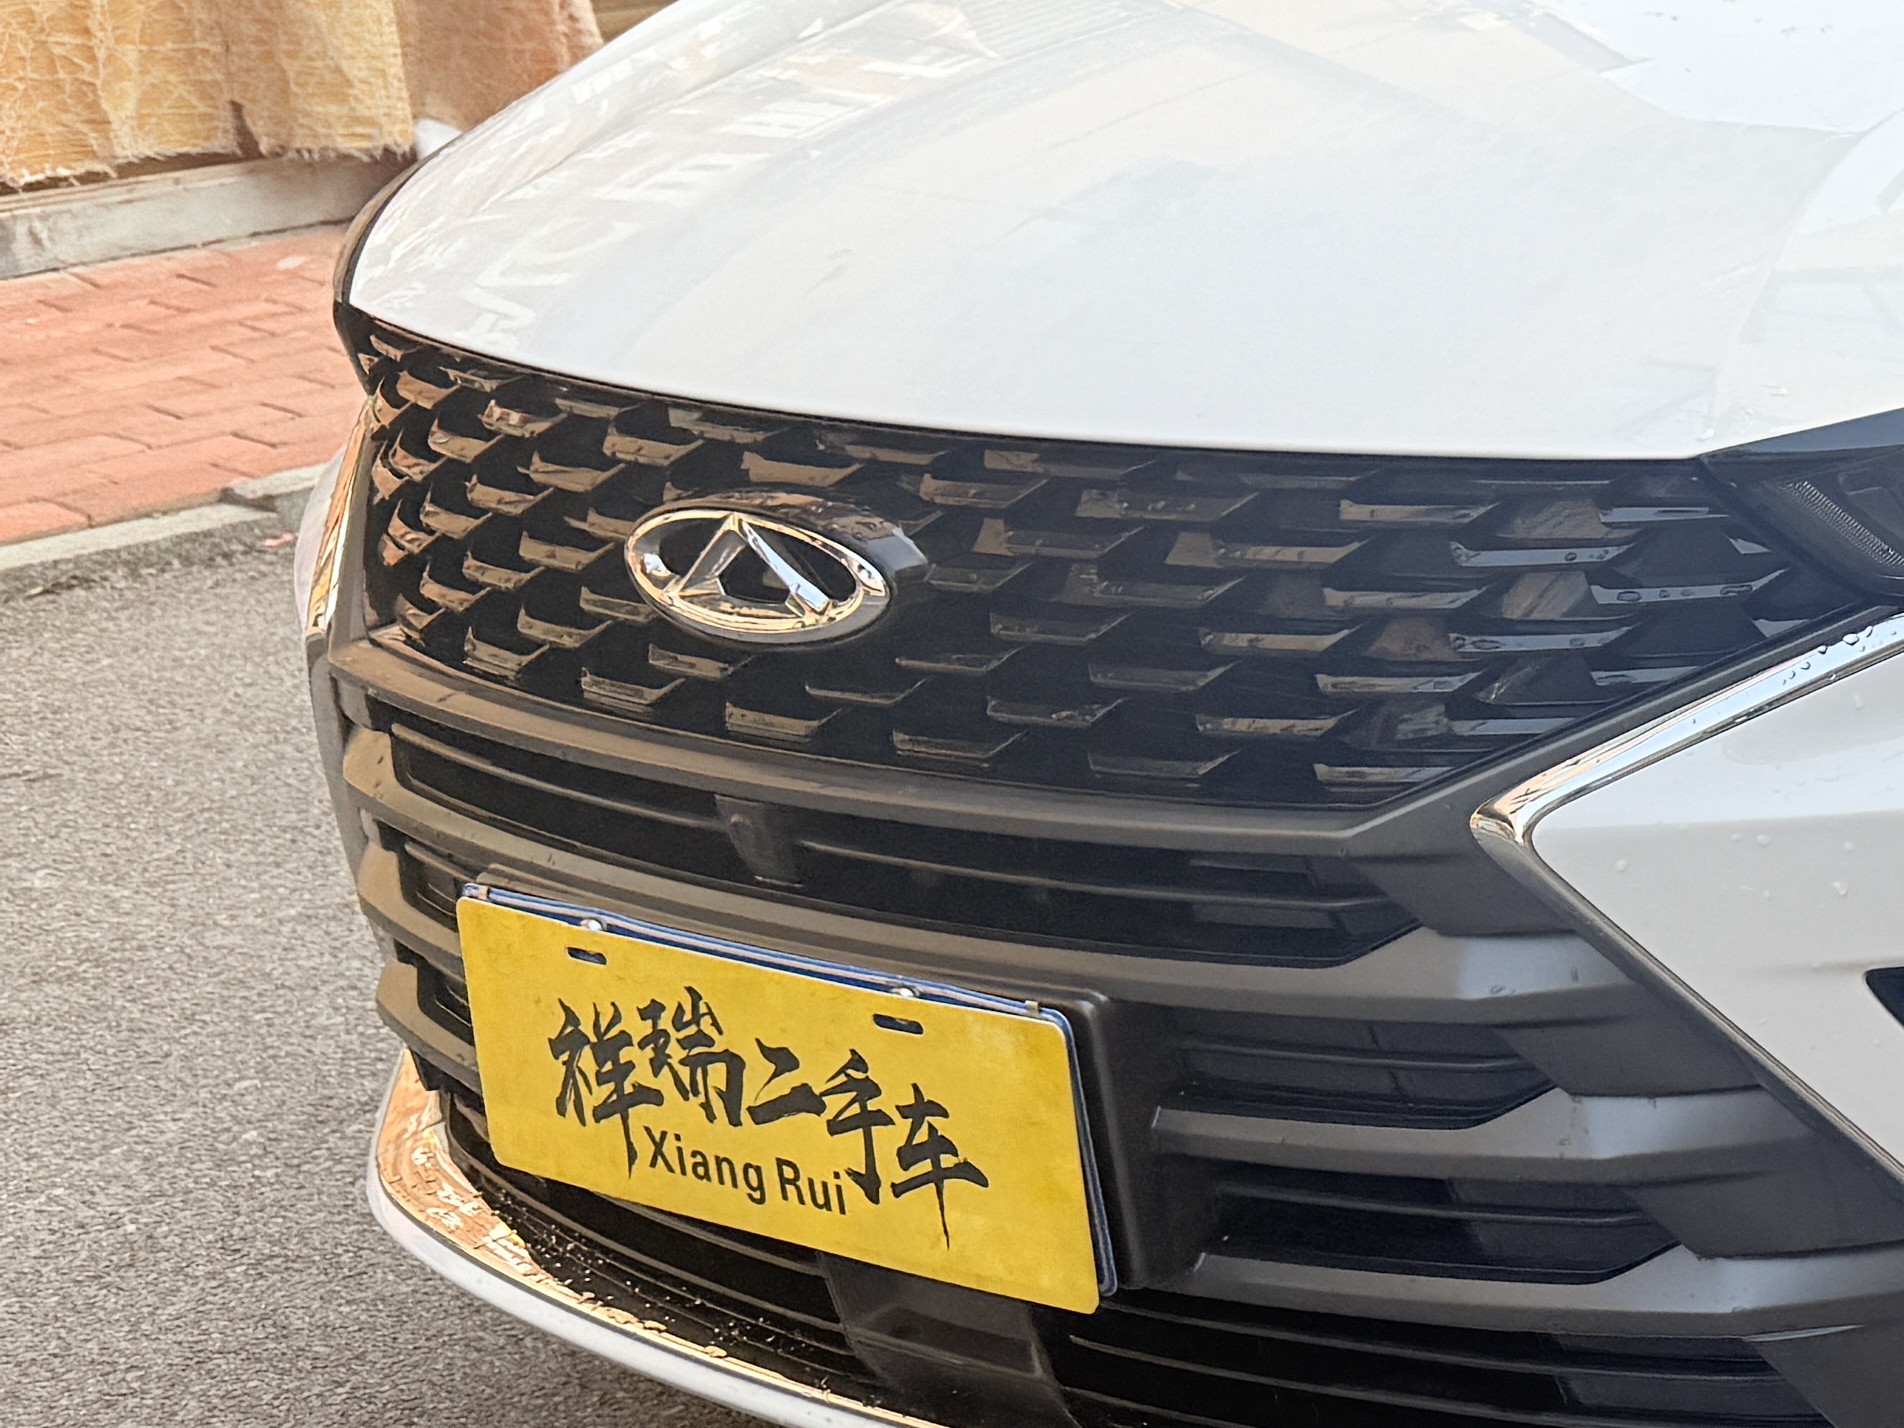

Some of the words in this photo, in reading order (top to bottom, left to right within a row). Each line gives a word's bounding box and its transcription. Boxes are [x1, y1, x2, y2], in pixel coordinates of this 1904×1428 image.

[548, 986, 990, 1249] 祥瑞二手车
[645, 1123, 767, 1206] Xiang
[777, 1158, 849, 1216] Rui
